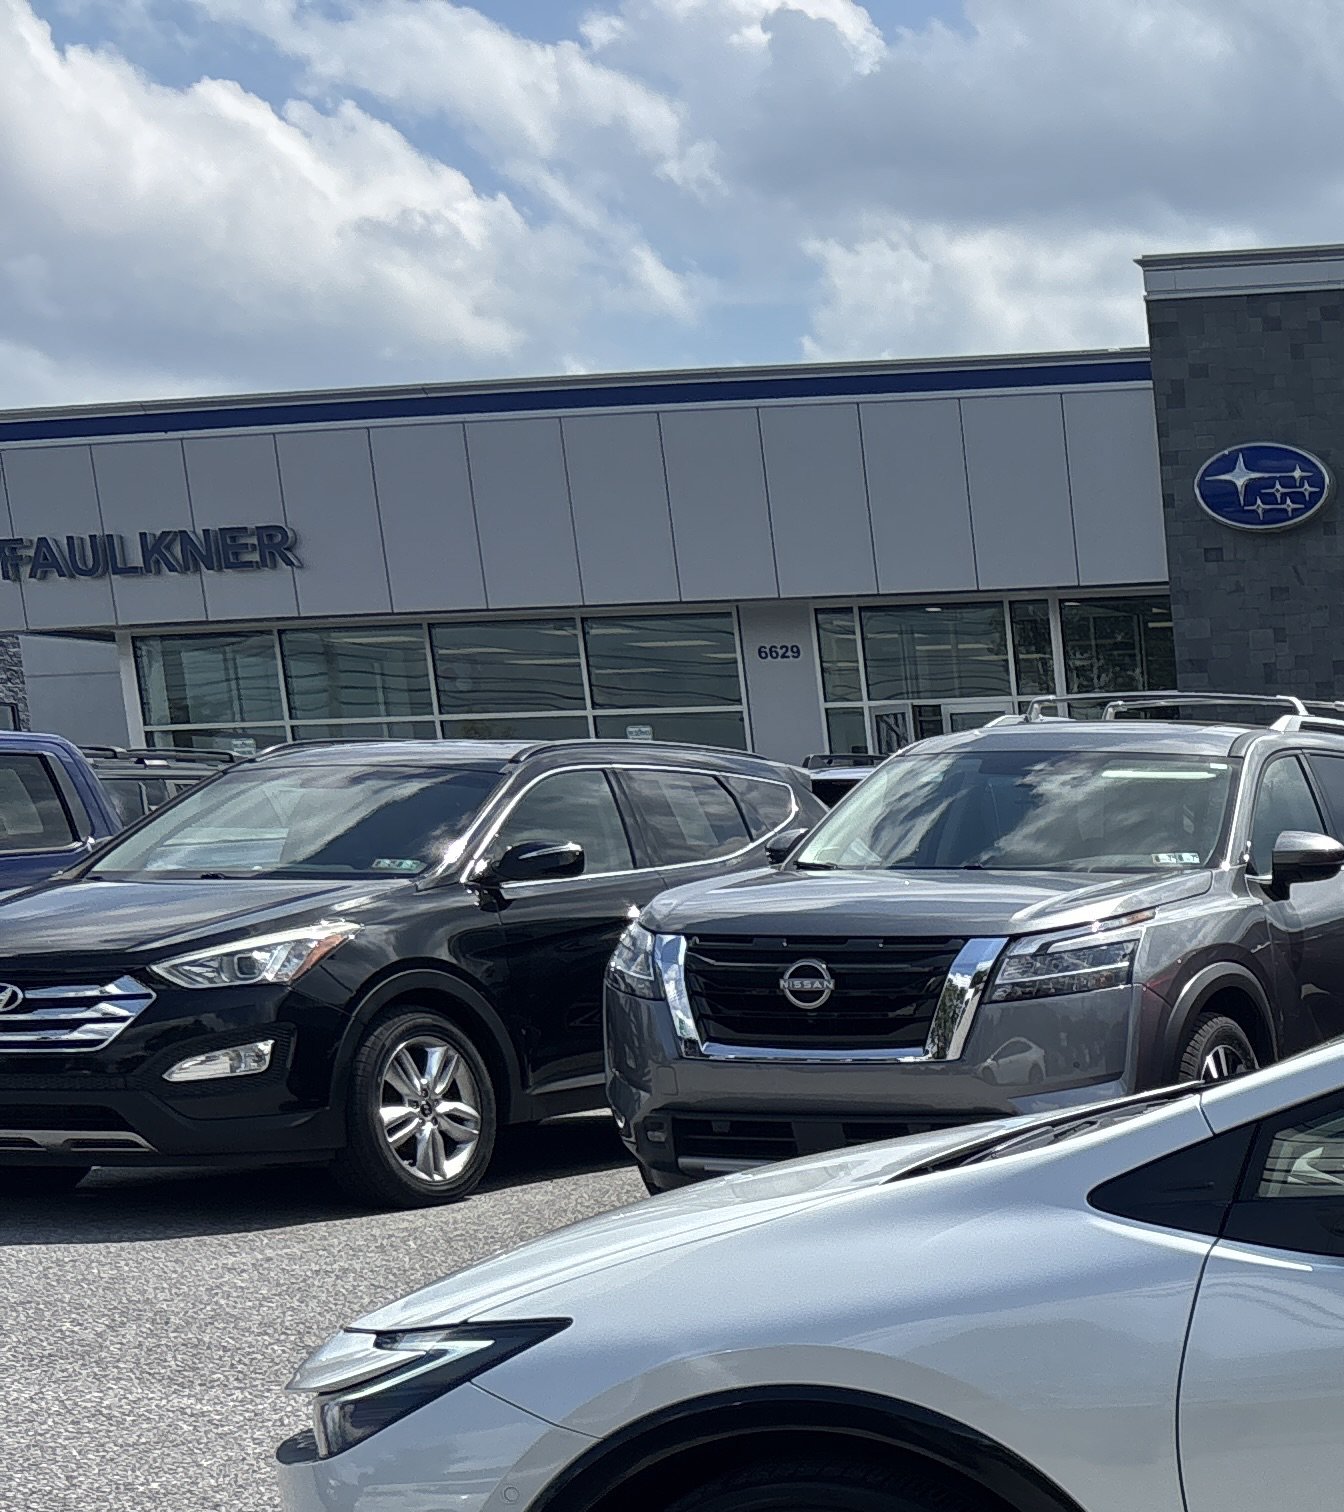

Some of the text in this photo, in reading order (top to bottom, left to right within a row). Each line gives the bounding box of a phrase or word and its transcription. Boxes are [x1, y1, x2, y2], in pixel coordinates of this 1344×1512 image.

[0, 524, 302, 582] FAULKNER
[757, 644, 801, 660] 6629
[779, 979, 835, 990] NISSAN
